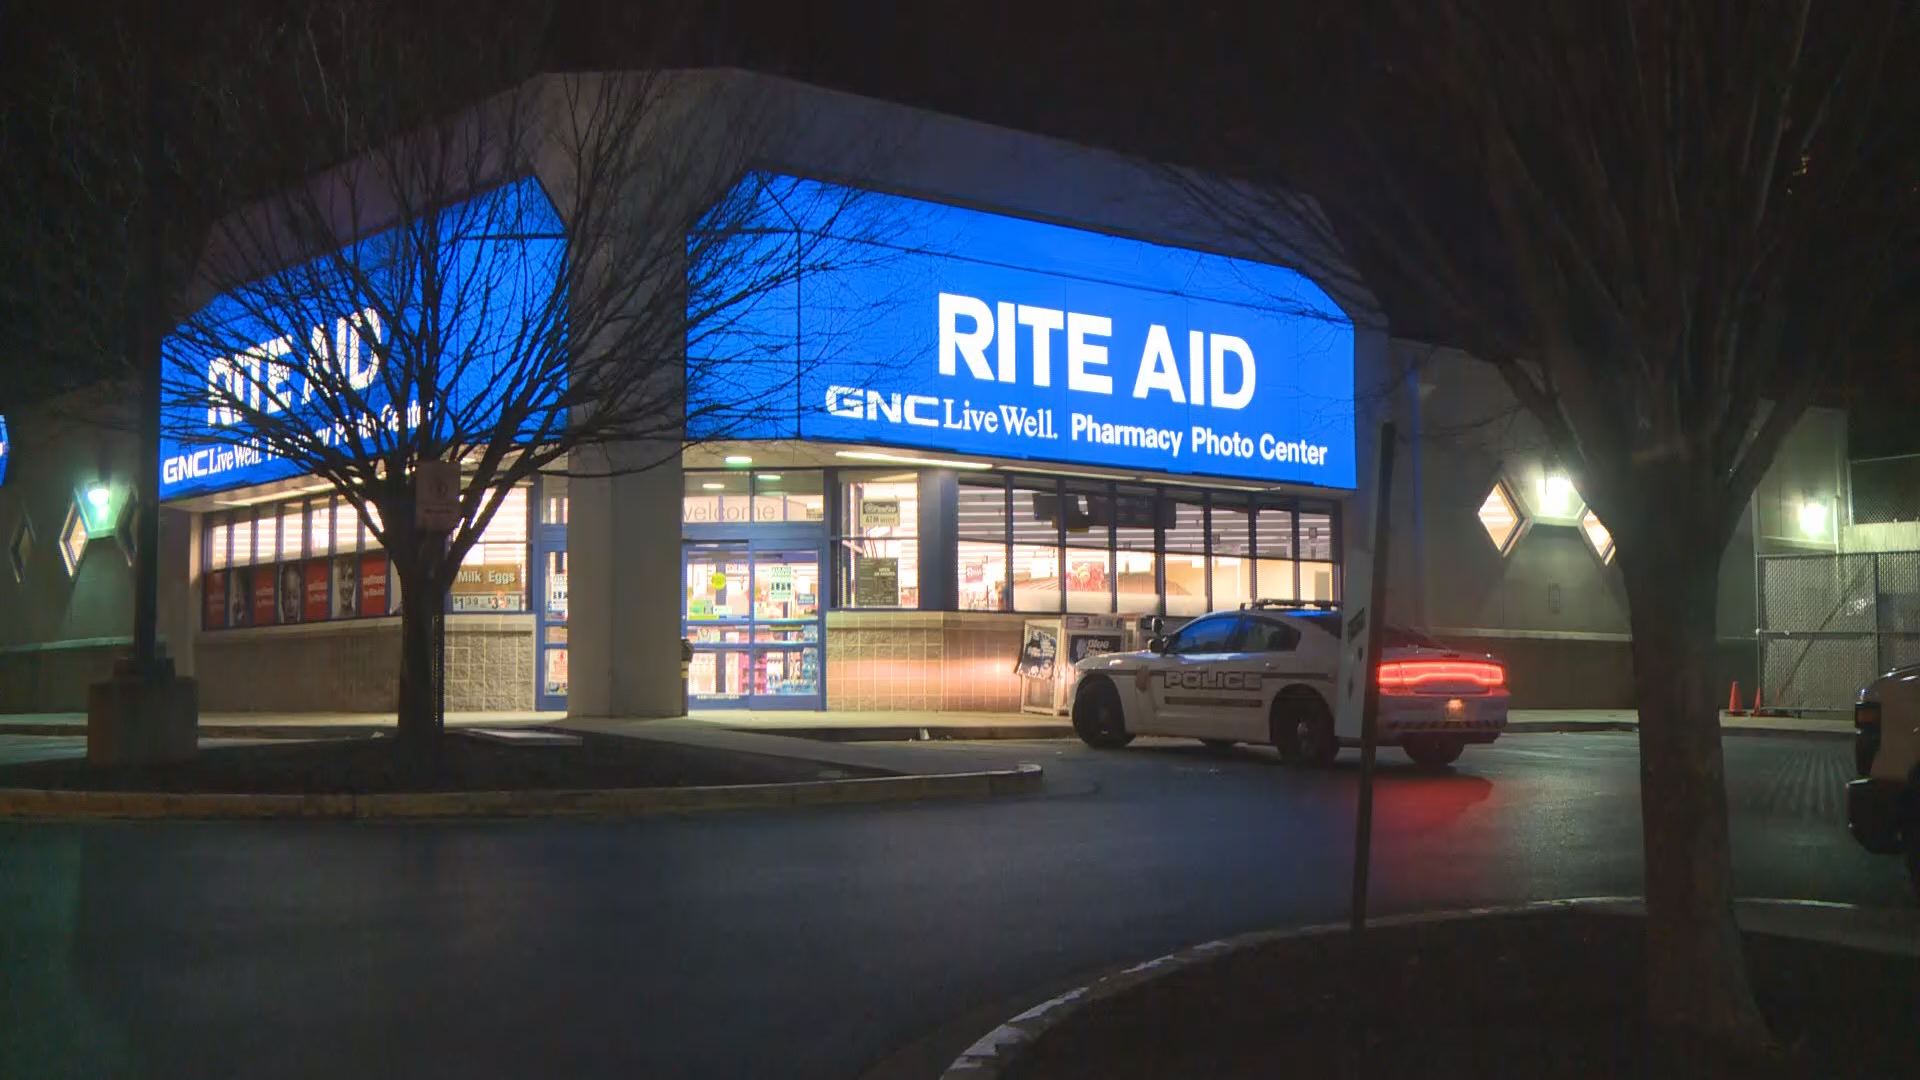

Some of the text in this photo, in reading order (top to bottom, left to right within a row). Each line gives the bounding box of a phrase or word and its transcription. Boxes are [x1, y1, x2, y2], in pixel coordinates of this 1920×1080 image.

[207, 307, 382, 427] RITE AID
[938, 292, 1256, 410] RITE AID
[825, 385, 940, 427] GNC
[1071, 412, 1183, 457] Pharmacy
[1191, 426, 1254, 459] Photo
[1259, 433, 1328, 466] Center
[163, 450, 209, 485] GNC
[457, 569, 516, 585] Milk Eggs
[1164, 670, 1263, 691] POLICE
